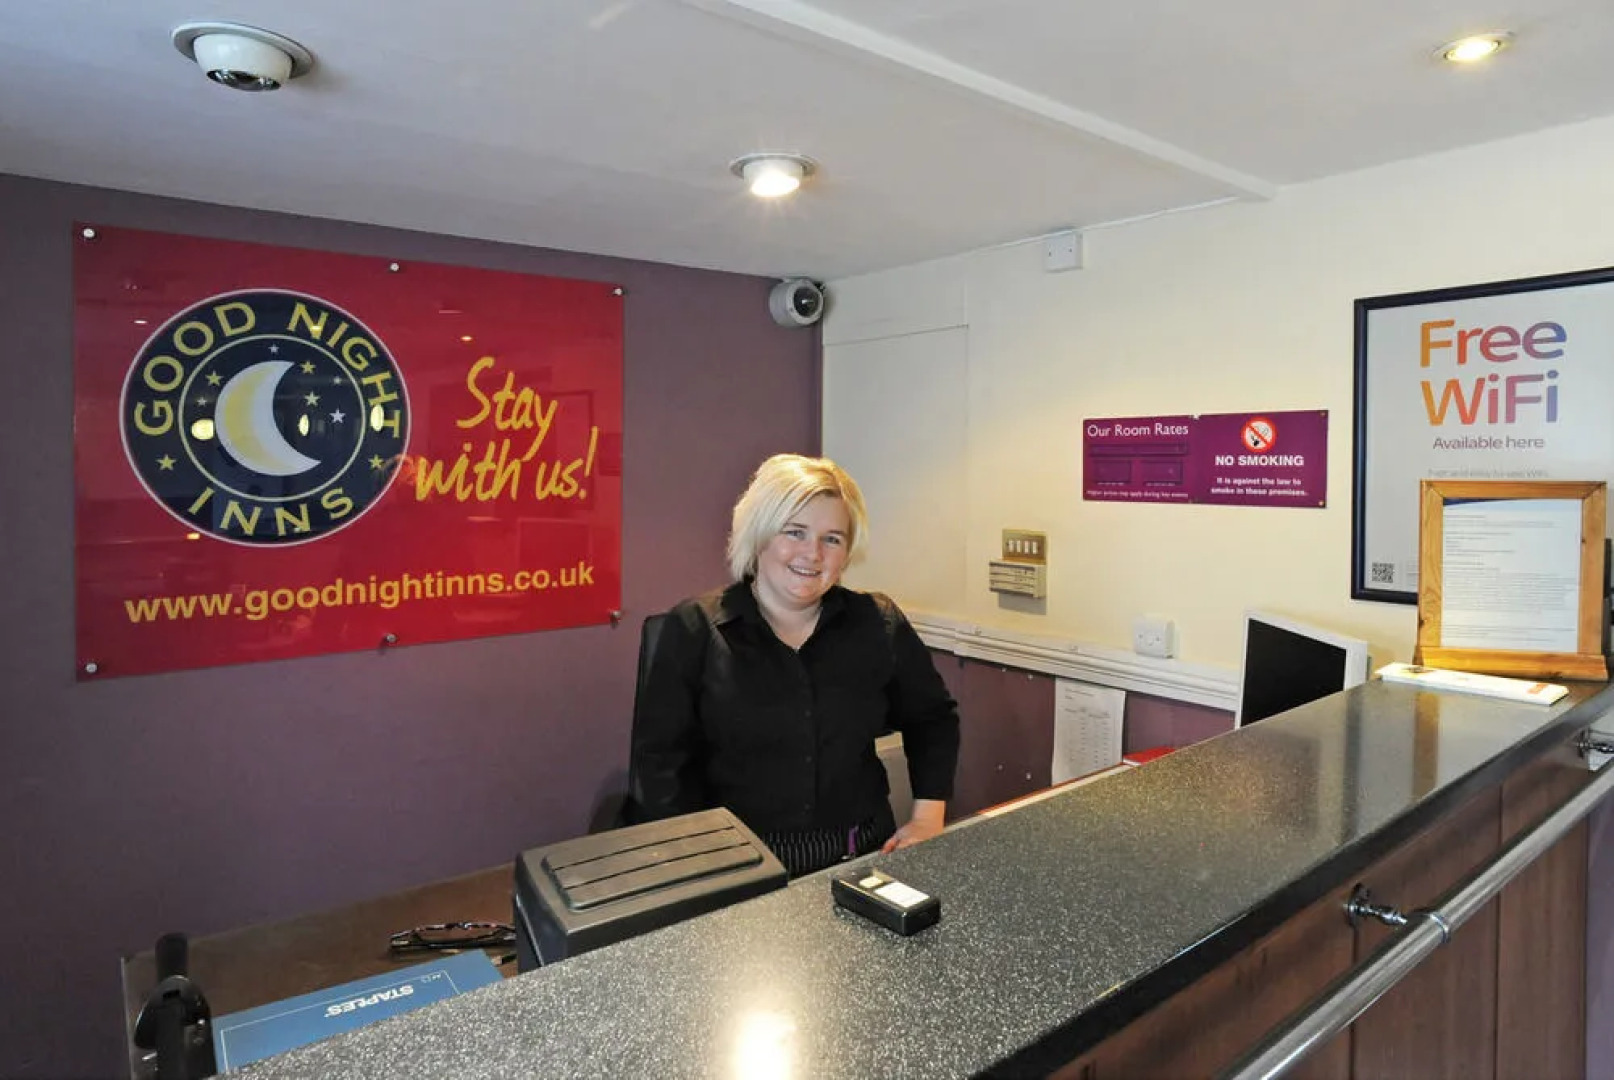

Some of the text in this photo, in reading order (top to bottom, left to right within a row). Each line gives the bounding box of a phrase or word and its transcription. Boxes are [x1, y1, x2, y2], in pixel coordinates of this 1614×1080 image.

[133, 300, 256, 436] GOOD
[1420, 319, 1567, 368] Free
[287, 302, 400, 438] NIGHT
[456, 355, 558, 461] Stay
[1420, 369, 1559, 426] WiFi
[1087, 422, 1189, 437] Our Room Rates
[1432, 434, 1545, 450] Available here
[415, 426, 599, 502] with us!
[1215, 454, 1305, 466] NO SMOKING
[1232, 477, 1260, 486] against
[1261, 477, 1275, 485] the
[1276, 477, 1291, 485] law
[1292, 477, 1302, 485] to
[187, 486, 355, 537] INNS
[1211, 487, 1234, 495] smoke
[1245, 487, 1268, 495] these
[124, 561, 595, 623] www.goodnightinns.co.uk
[325, 984, 414, 1017] STAPLES
